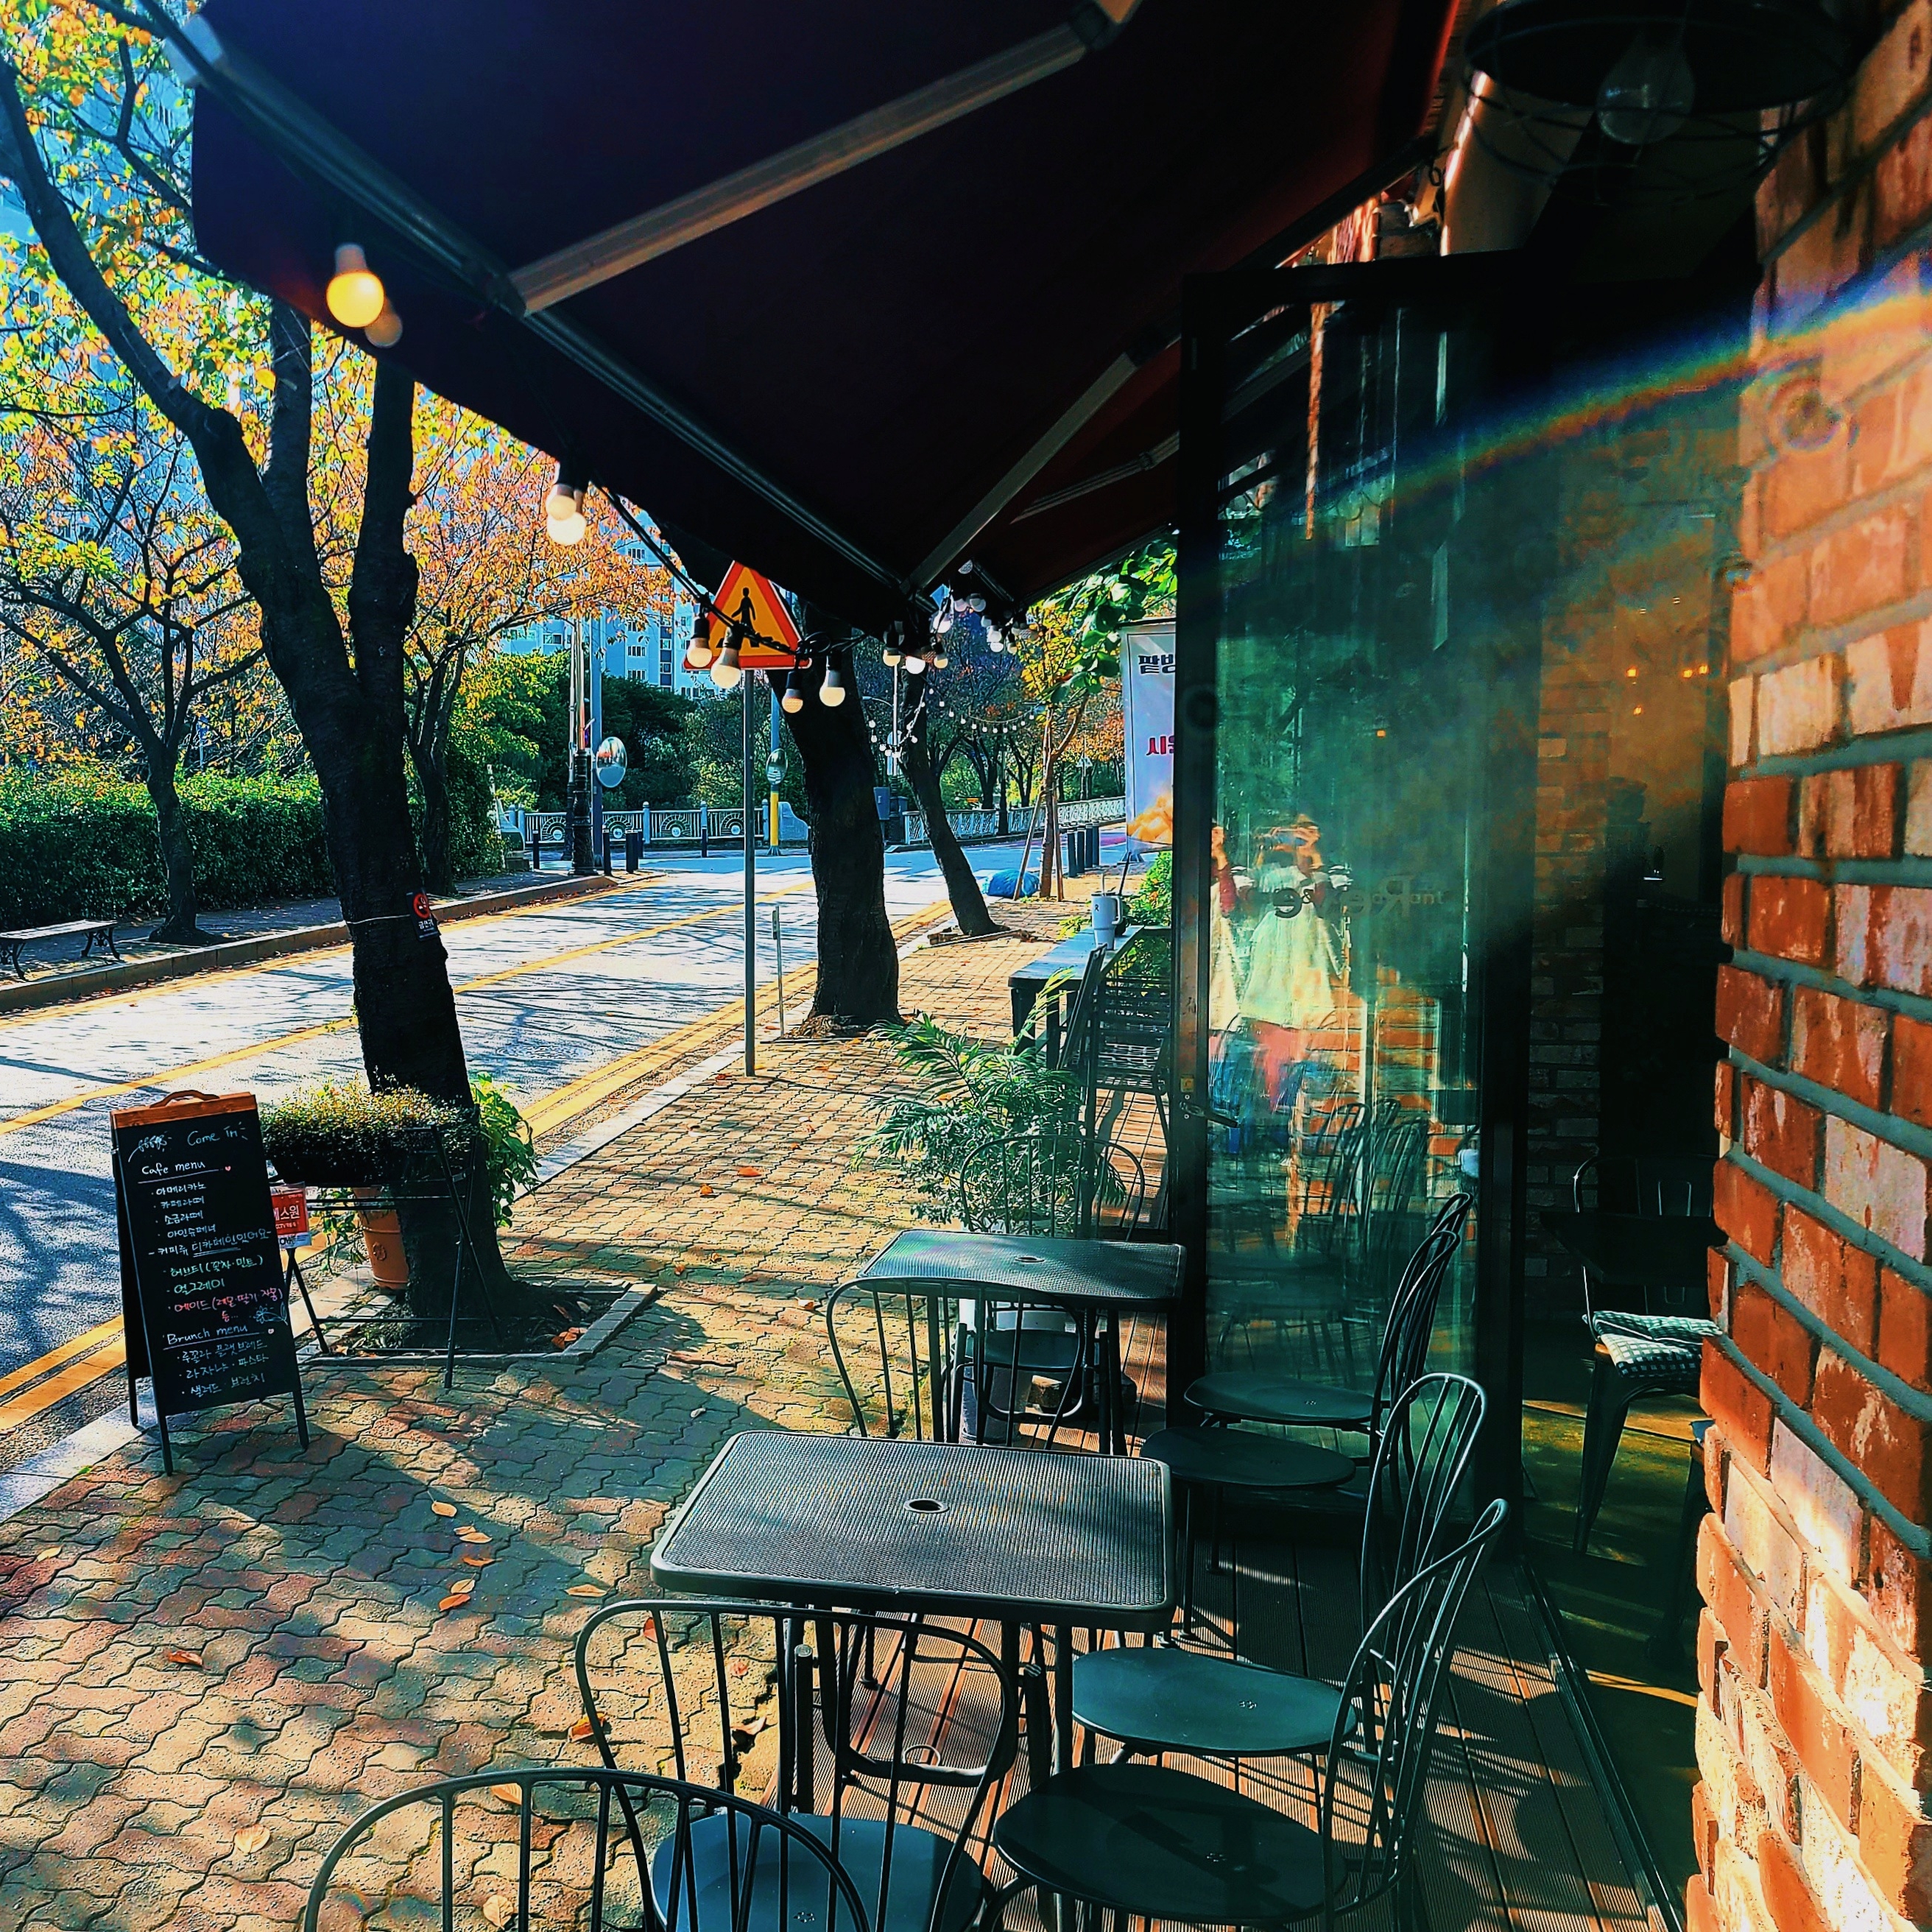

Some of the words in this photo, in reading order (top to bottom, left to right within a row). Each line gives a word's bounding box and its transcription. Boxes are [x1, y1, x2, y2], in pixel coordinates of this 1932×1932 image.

[187, 1130, 220, 1146] Come
[141, 1163, 169, 1176] Cafe
[175, 1161, 205, 1171] menu
[156, 1182, 207, 1195] 아메리카노
[161, 1196, 205, 1209] 카페라떼
[165, 1210, 203, 1225] 소금라떼
[167, 1224, 216, 1238] 아인슈페너
[174, 1278, 225, 1295] 얼그레이
[167, 1328, 211, 1345] Brunch
[216, 1325, 248, 1336] menu
[182, 1349, 211, 1364] 루꼴라
[239, 1353, 269, 1367] 파스타
[191, 1383, 222, 1397] 샐러드
[231, 1372, 266, 1388] 브런치
